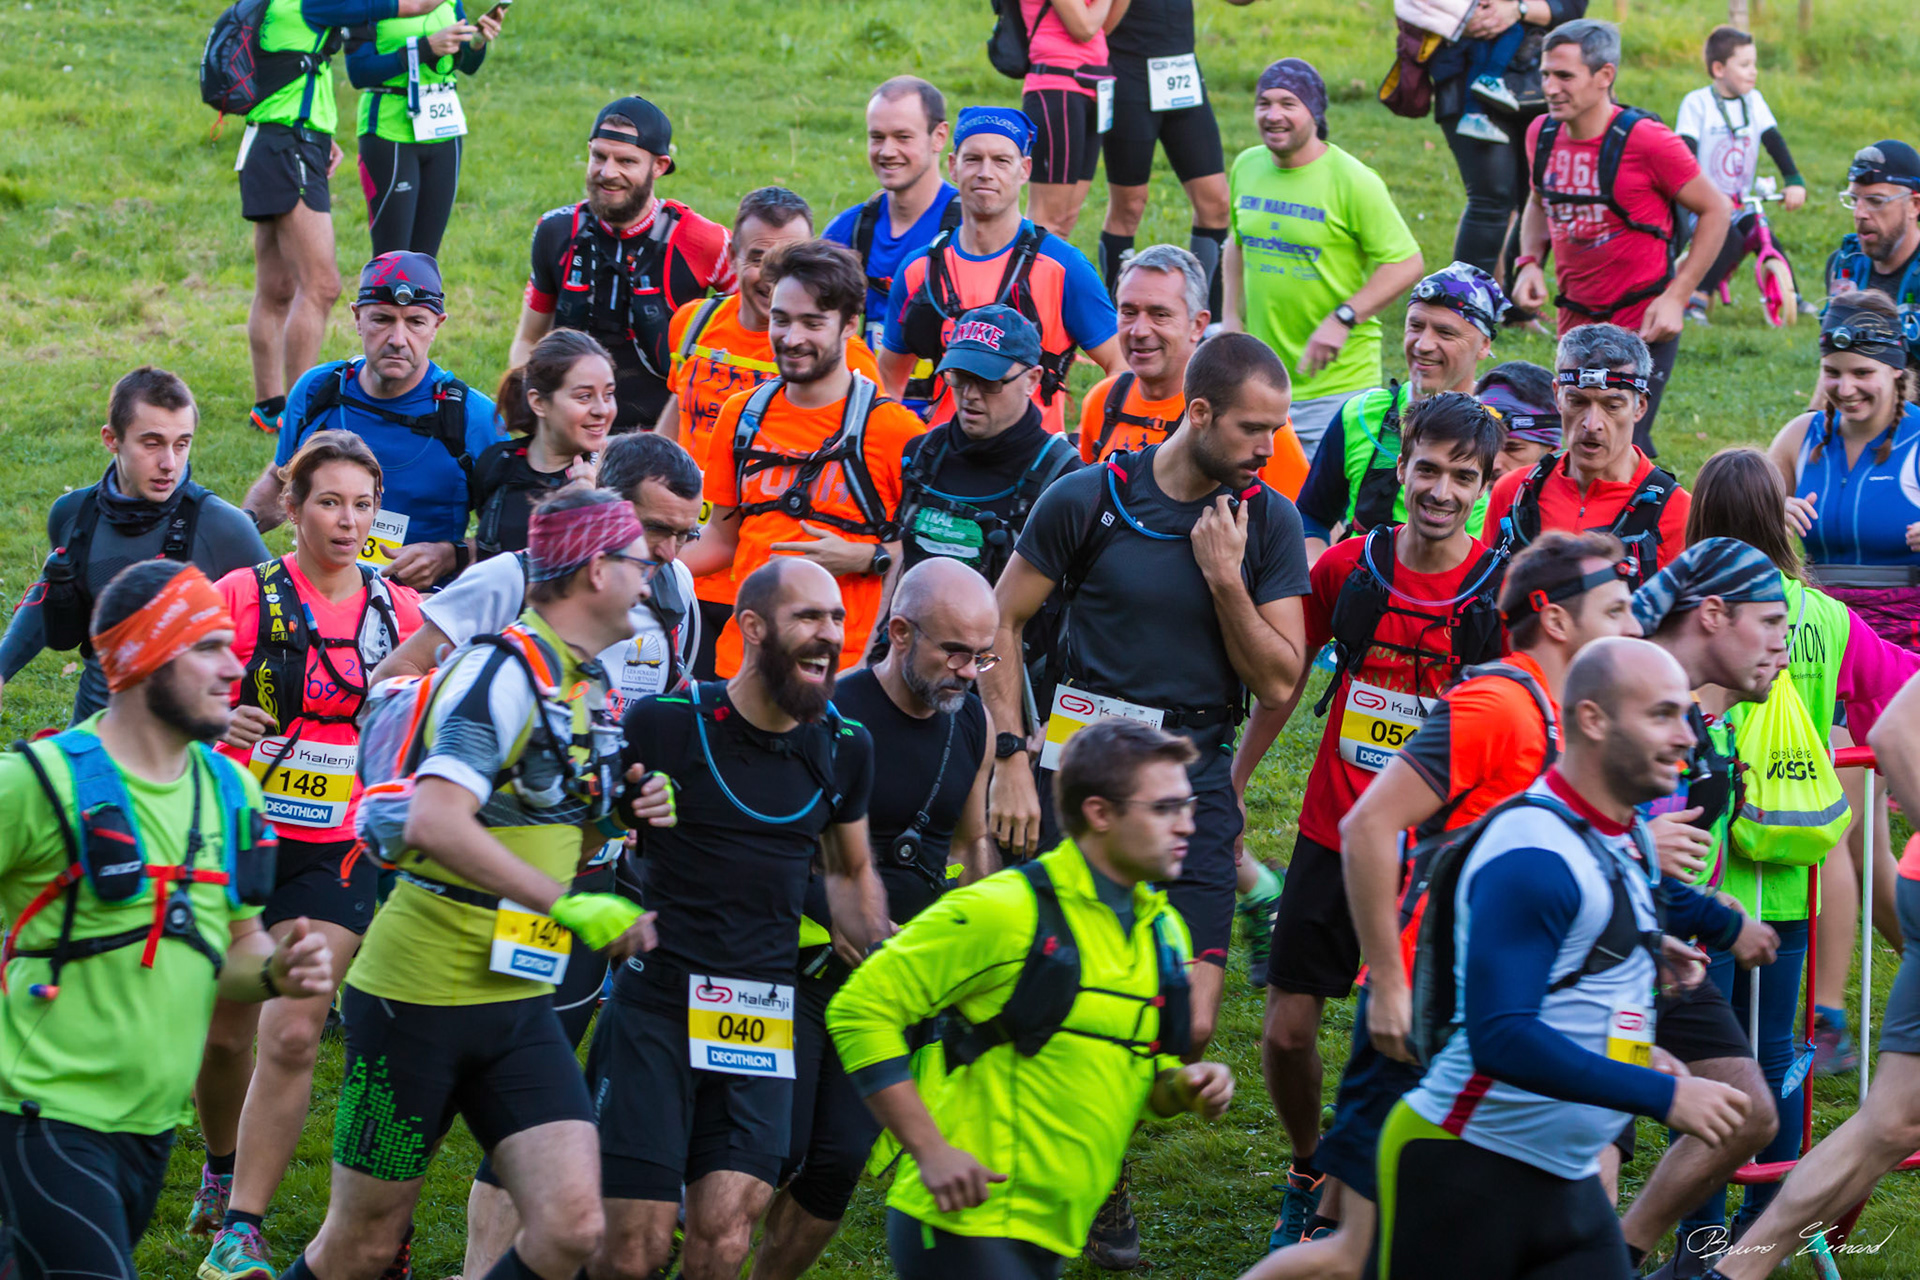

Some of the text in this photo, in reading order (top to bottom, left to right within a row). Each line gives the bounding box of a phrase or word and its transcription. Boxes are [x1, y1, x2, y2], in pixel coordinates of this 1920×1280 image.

[1167, 75, 1191, 90] 972
[430, 103, 453, 119] 524
[953, 321, 1006, 351] NIKE
[372, 518, 404, 536] lenji
[263, 583, 286, 633] HOKA
[1785, 622, 1826, 664] TION
[299, 749, 355, 769] Kalenji
[280, 770, 328, 797] 148
[265, 800, 329, 820] DECATHLON
[529, 919, 562, 948] 140
[737, 991, 790, 1012] Kalenji
[718, 1015, 765, 1043] 040
[711, 1050, 773, 1068] DECATHLON
